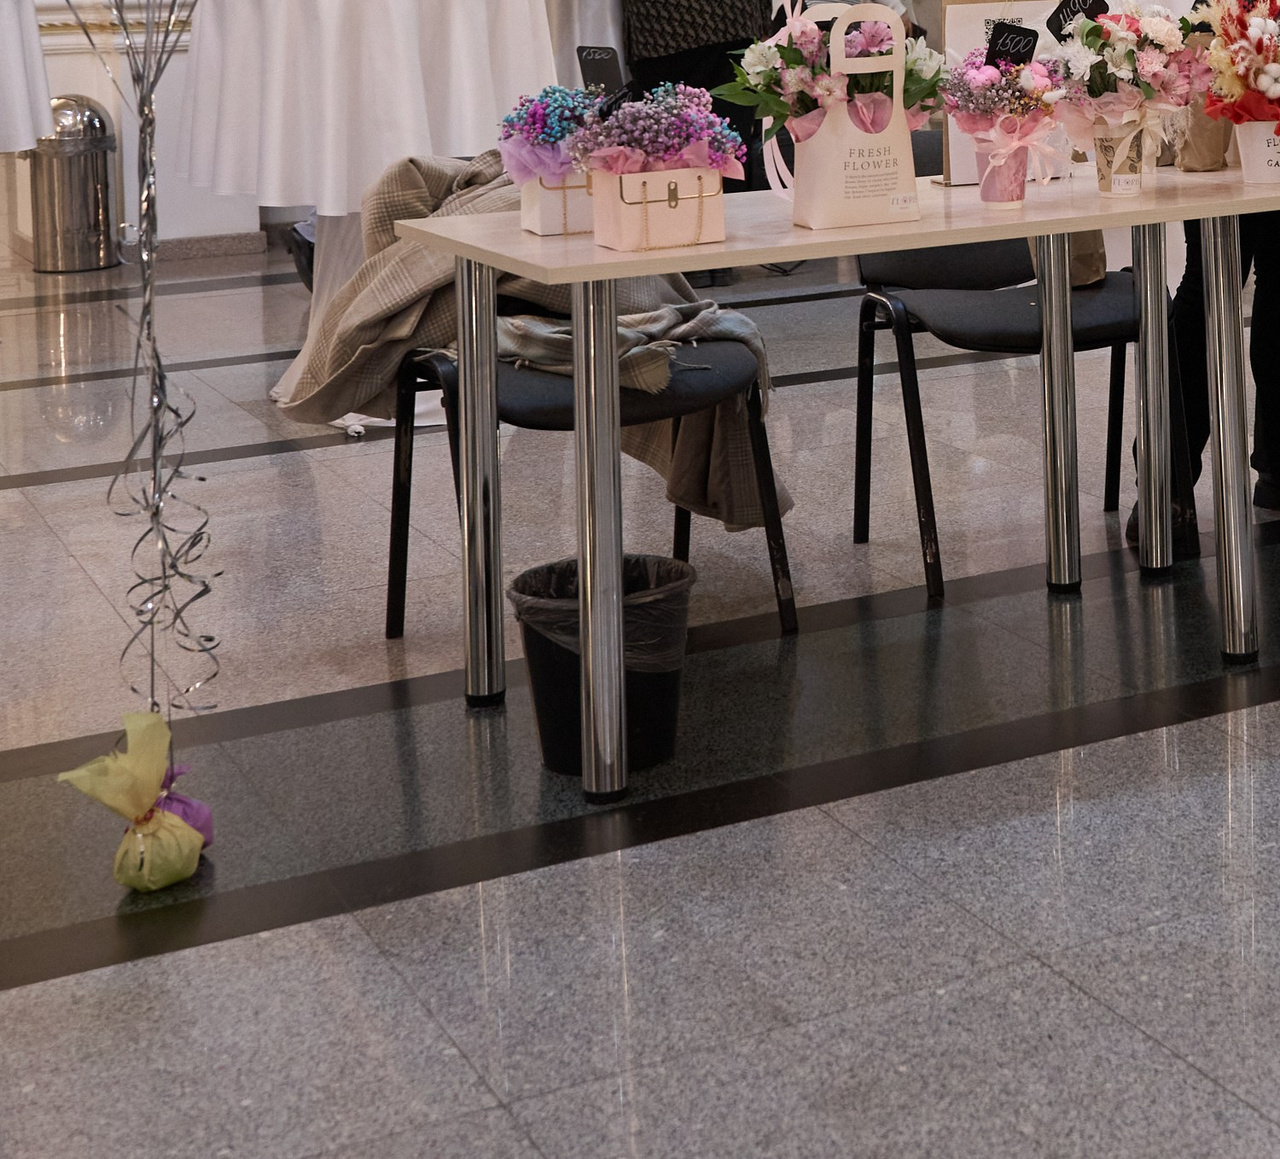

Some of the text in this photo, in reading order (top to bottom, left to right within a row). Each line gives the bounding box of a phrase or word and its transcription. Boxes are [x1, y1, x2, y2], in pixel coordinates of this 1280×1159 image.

[995, 32, 1034, 54] 1500
[582, 48, 613, 60] 1500
[849, 146, 891, 158] FRESH
[843, 157, 899, 171] FLOWER
